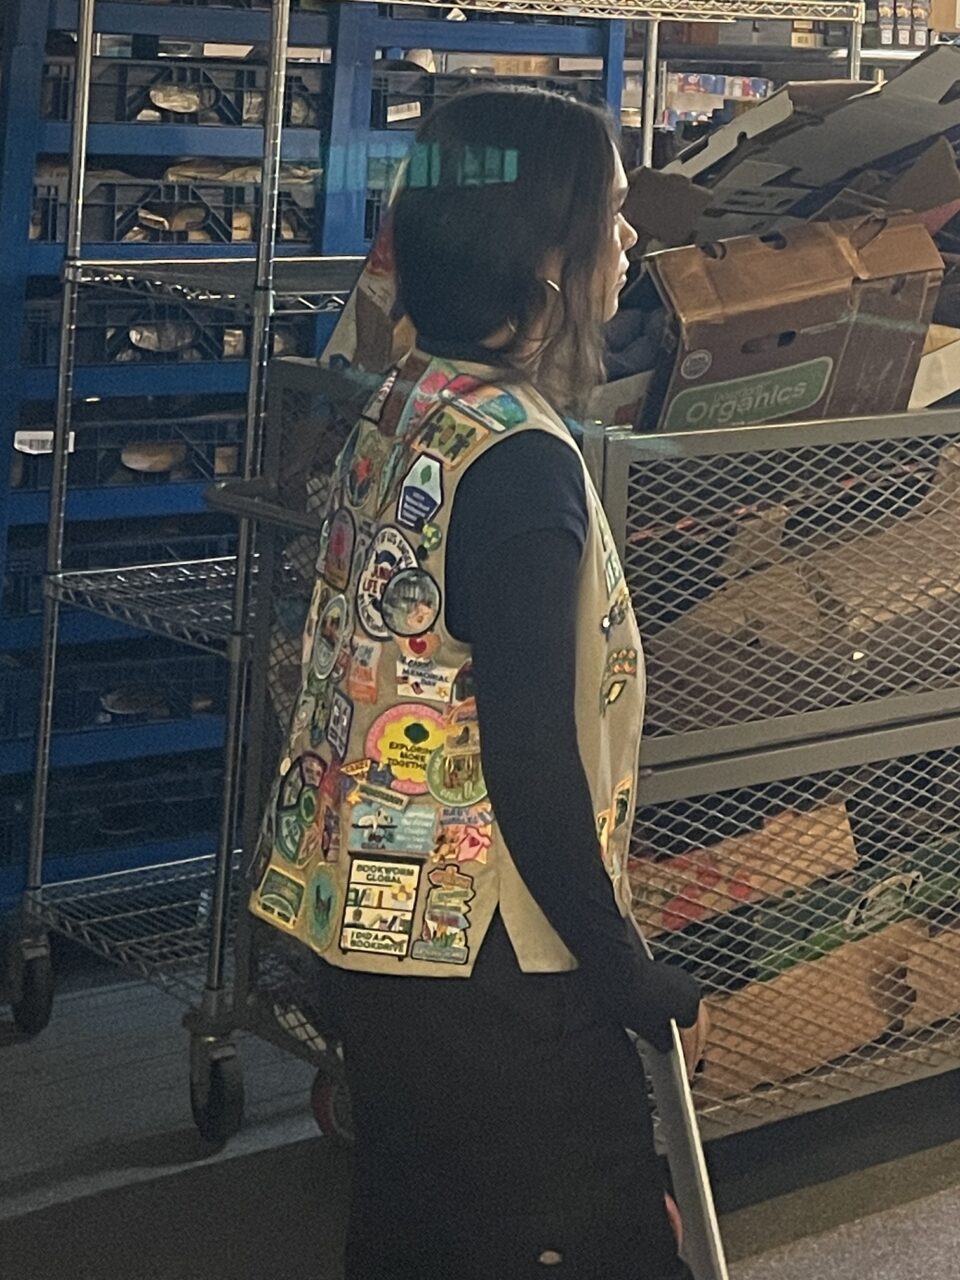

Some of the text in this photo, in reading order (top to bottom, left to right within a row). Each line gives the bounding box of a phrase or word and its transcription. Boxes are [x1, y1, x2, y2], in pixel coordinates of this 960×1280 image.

[685, 380, 808, 424] Organics
[402, 668, 450, 683] MEMORIAL
[400, 751, 426, 763] MORE
[356, 864, 415, 877] BOOKWORM
[366, 874, 402, 884] GLOBAL
